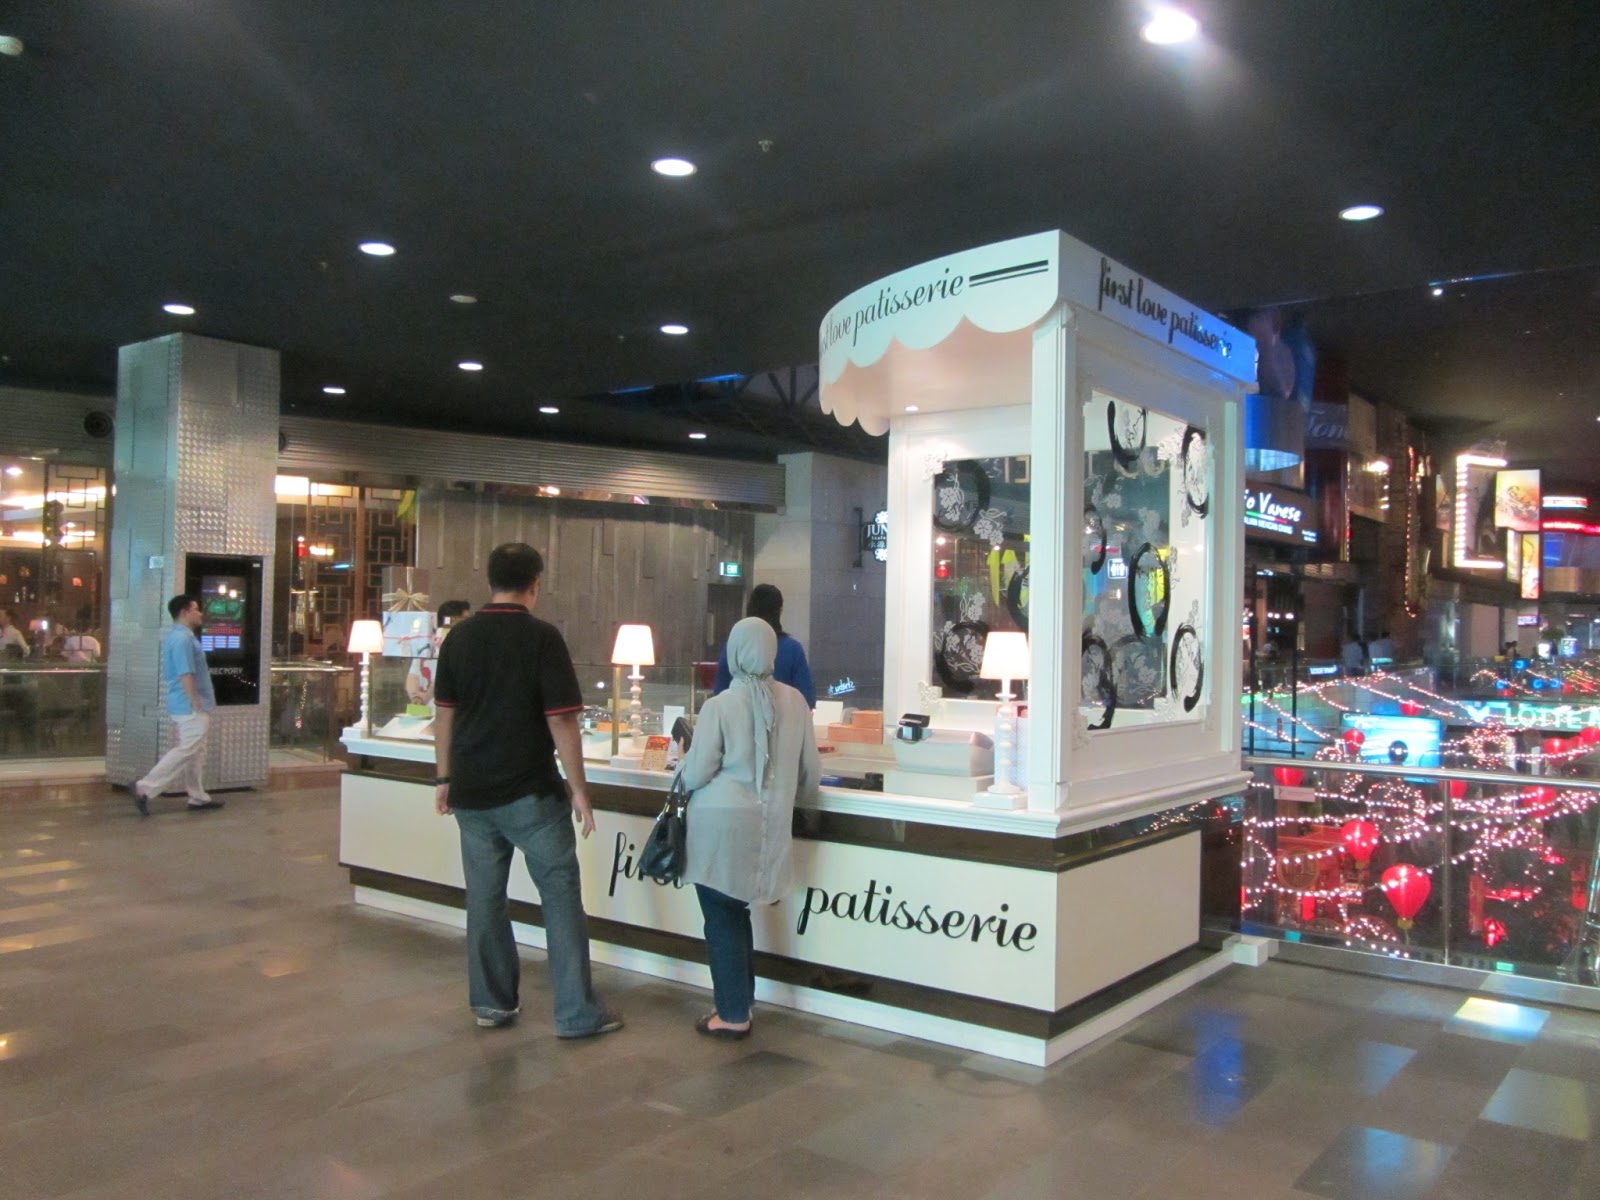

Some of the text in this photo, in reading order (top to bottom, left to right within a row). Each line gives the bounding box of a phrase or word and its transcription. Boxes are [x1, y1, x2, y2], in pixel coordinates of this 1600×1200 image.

[829, 313, 852, 347] love
[852, 267, 964, 347] patisserie
[1098, 256, 1233, 361] first love patisserie
[1504, 706, 1582, 729] LOTTE
[796, 878, 1038, 953] patisserie
